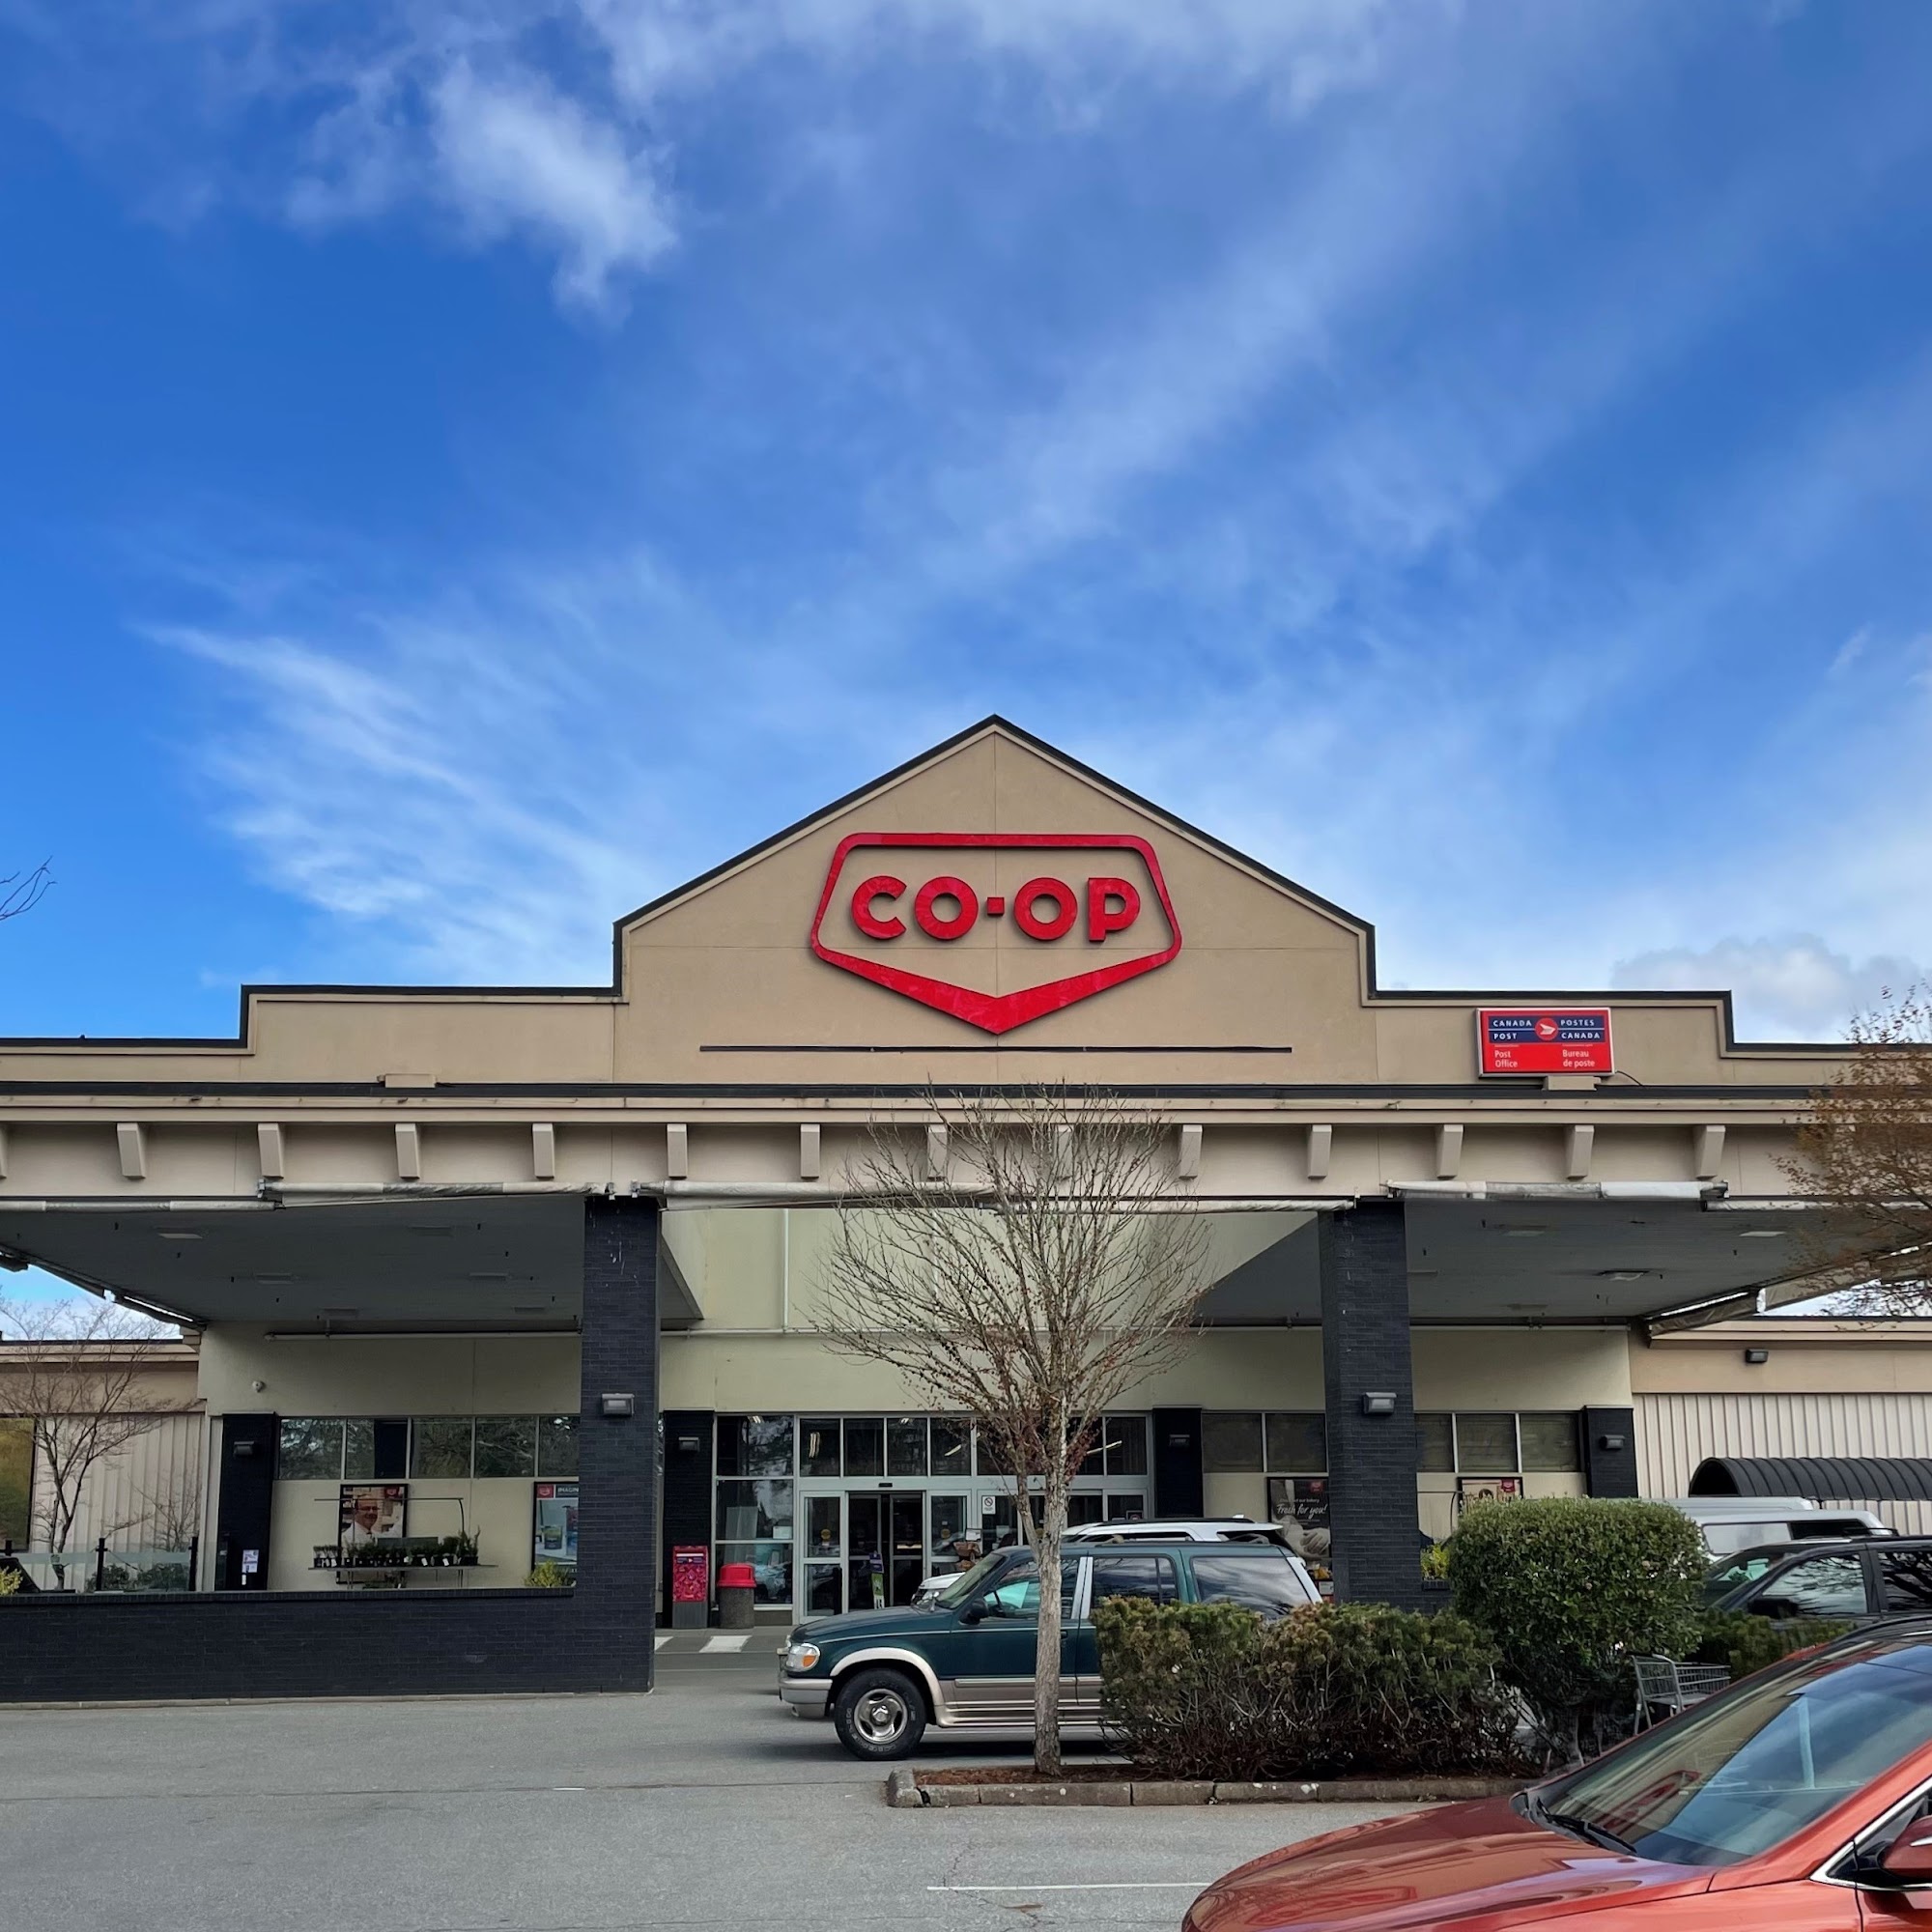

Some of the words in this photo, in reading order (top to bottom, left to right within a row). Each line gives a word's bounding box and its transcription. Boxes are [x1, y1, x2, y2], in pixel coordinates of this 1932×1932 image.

[851, 875, 1141, 941] CO-OP
[1562, 1049, 1589, 1058] Bureau
[1494, 1060, 1518, 1068] Office
[1574, 1061, 1595, 1069] poste
[1276, 1503, 1295, 1514] Fresh
[1297, 1503, 1308, 1515] for
[1308, 1503, 1328, 1520] you!
